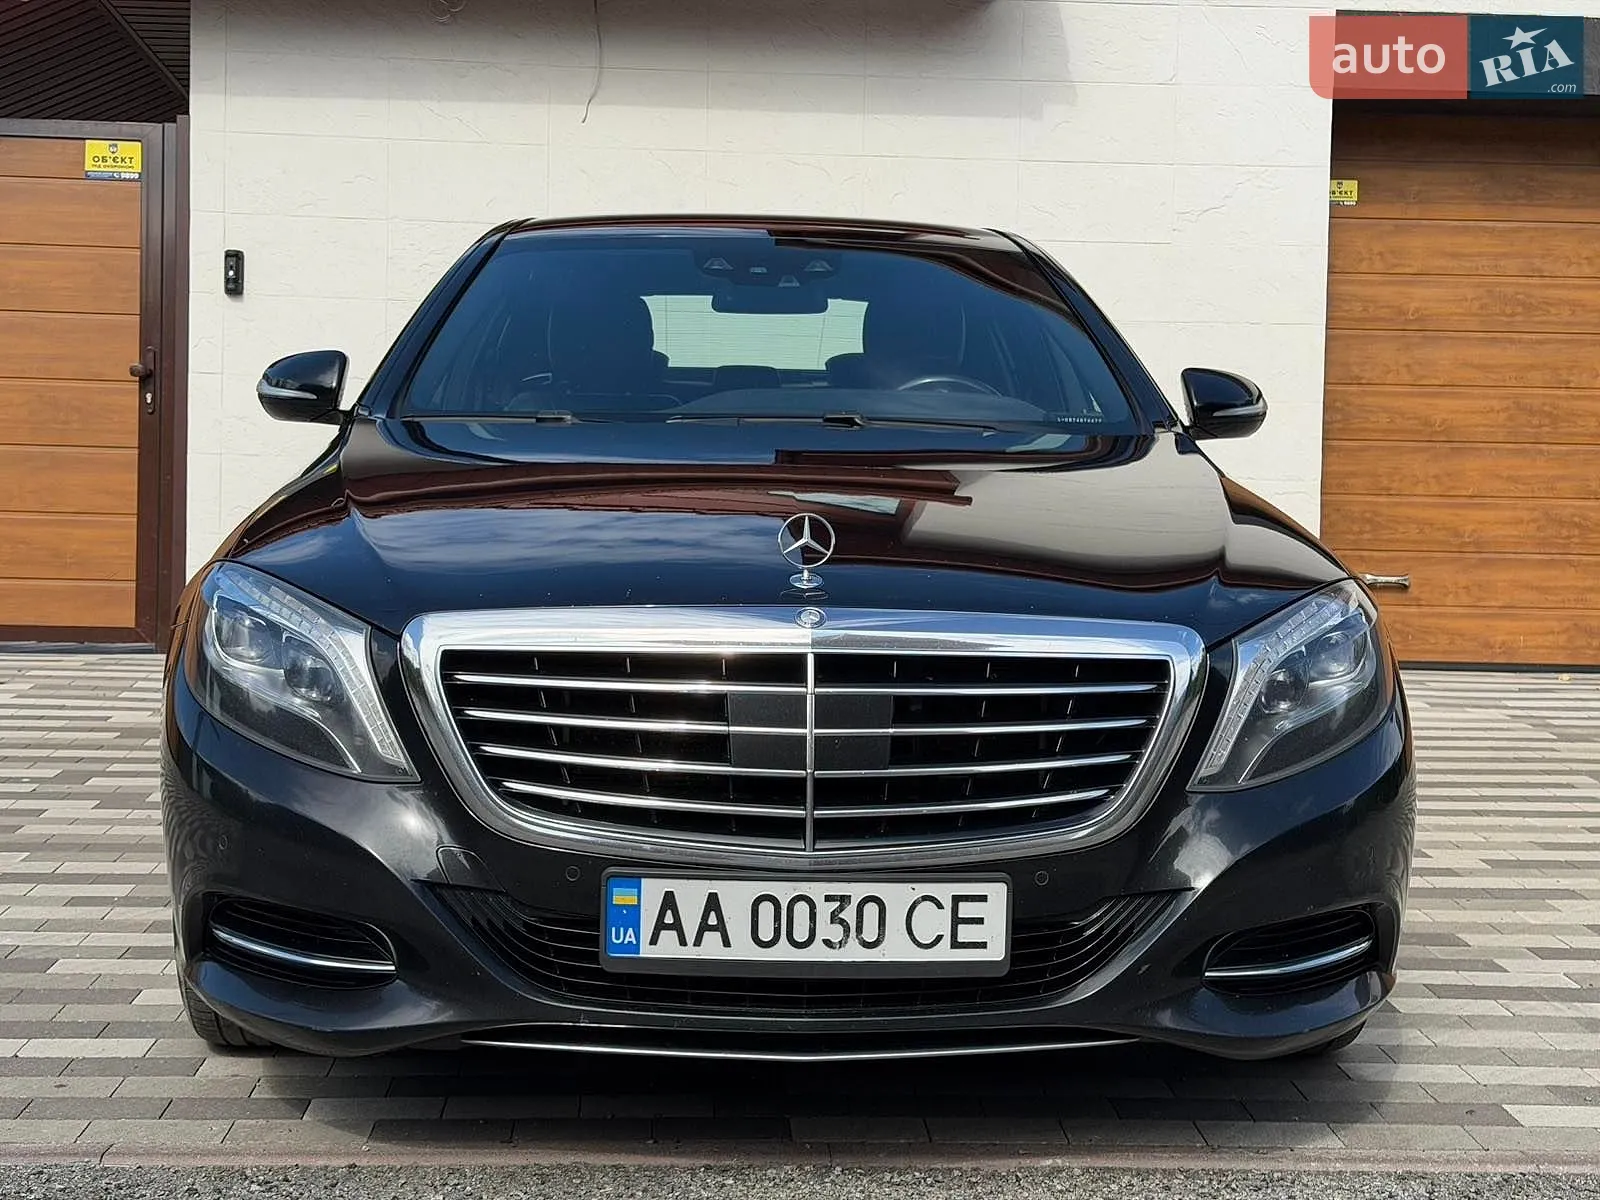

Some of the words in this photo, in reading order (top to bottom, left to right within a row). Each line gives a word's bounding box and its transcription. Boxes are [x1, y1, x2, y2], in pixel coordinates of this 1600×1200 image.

[611, 927, 637, 945] UA
[648, 890, 732, 948] AA
[750, 893, 887, 950] 0030
[905, 894, 989, 950] CE
